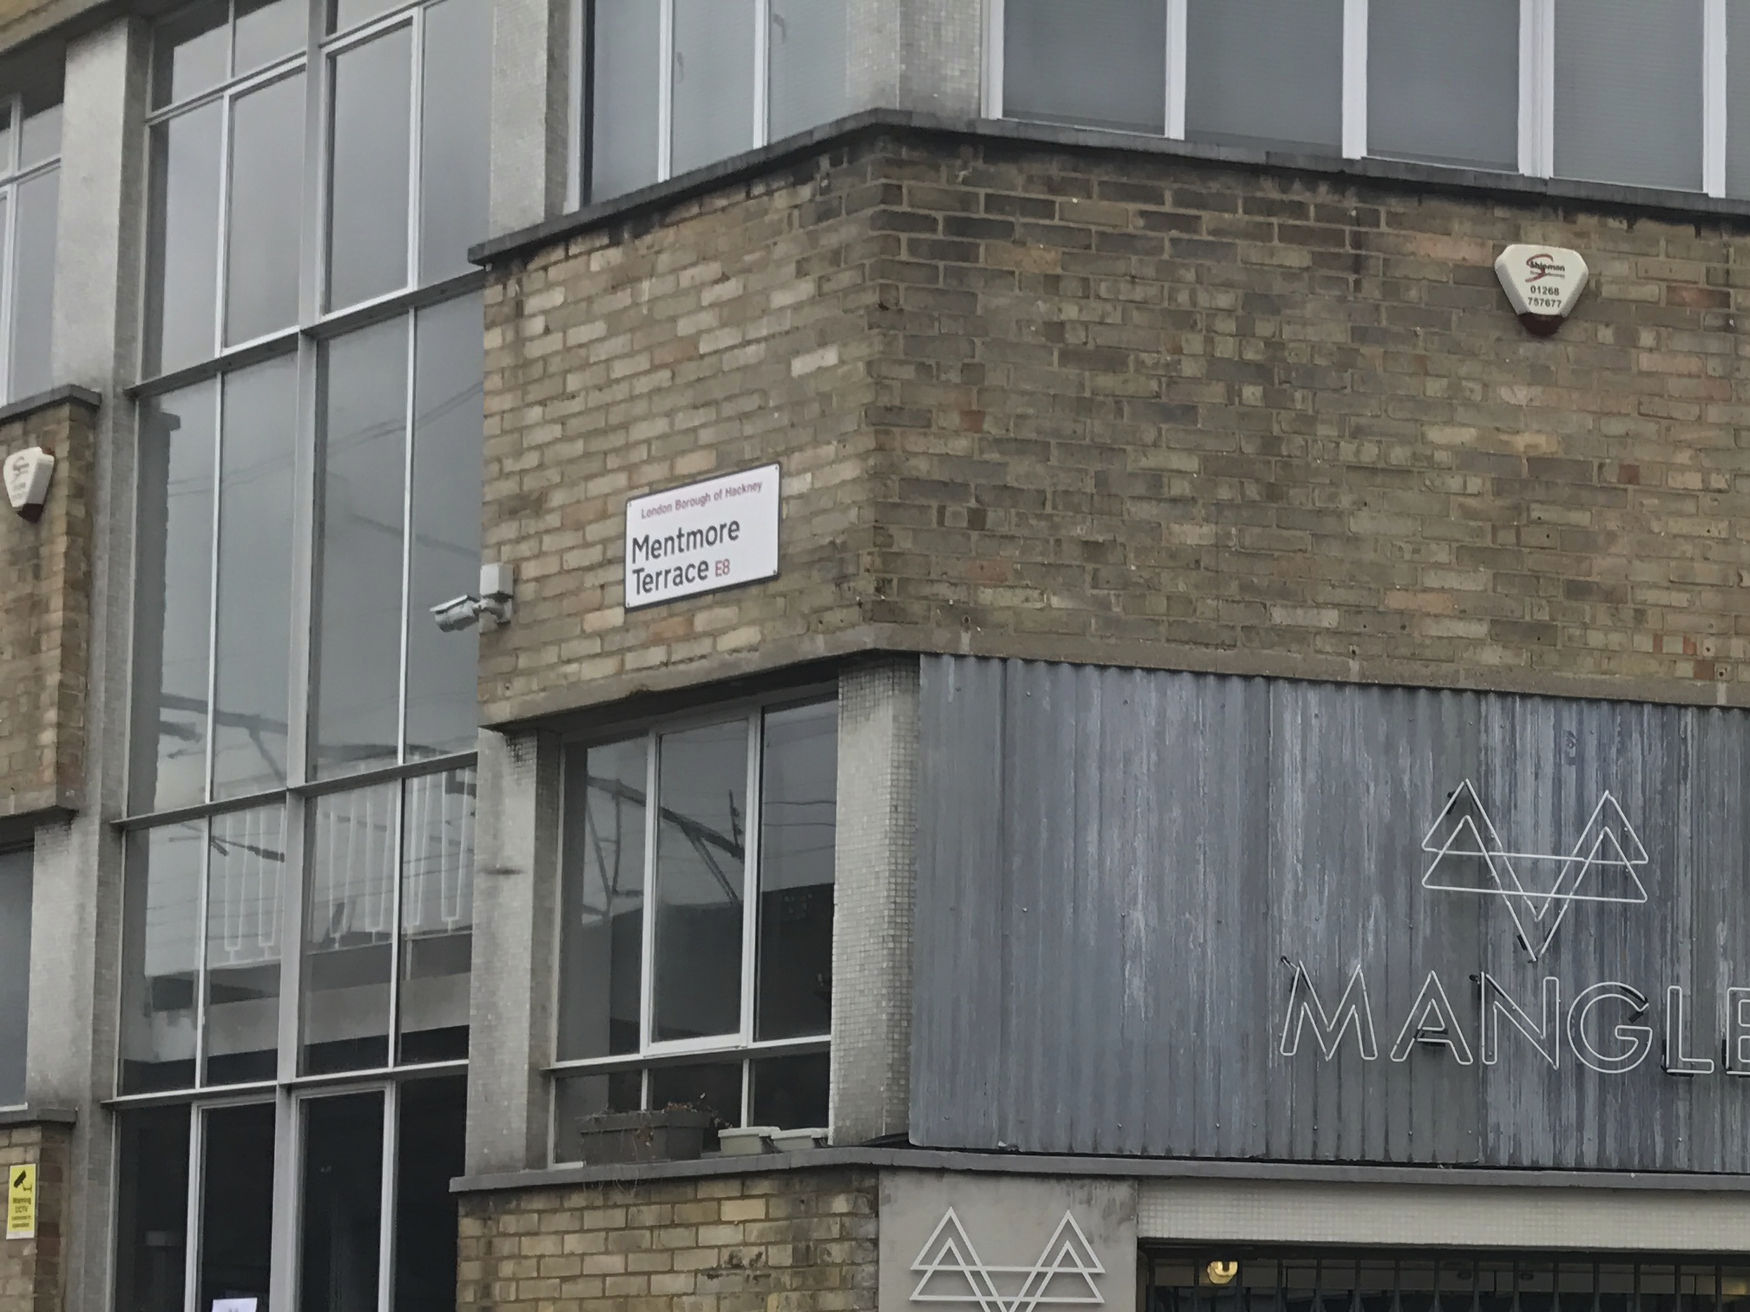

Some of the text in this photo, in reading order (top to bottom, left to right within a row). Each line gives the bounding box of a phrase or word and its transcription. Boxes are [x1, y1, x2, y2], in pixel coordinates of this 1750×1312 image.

[1530, 285, 1560, 296] 01268
[641, 480, 763, 519] London Borough of Hackney
[632, 519, 740, 564] Mentmore
[632, 558, 731, 595] Terrace E8
